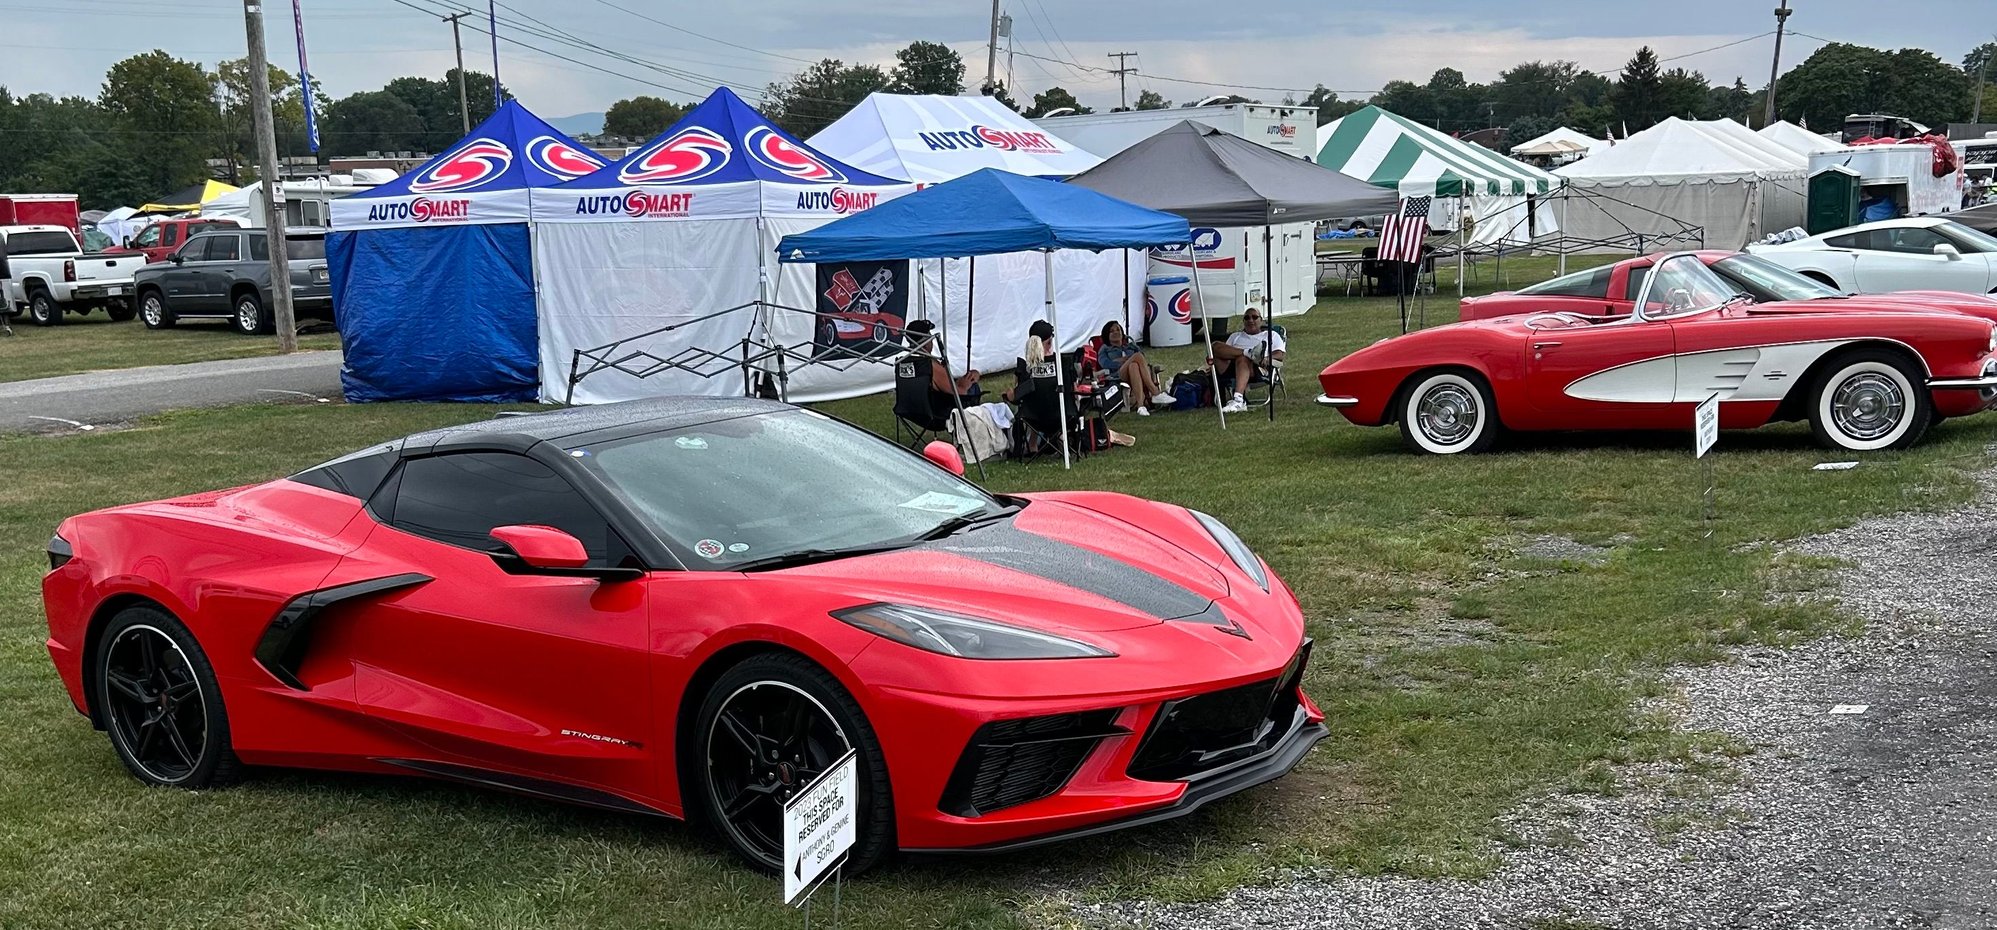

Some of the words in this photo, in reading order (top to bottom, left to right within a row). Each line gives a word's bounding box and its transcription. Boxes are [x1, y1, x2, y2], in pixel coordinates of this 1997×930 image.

[918, 125, 1056, 151] AUTOSMART
[368, 197, 469, 222] AUTOSMART
[576, 190, 692, 217] AUTOSMART
[561, 729, 628, 745] STINGRAY
[793, 796, 812, 821] 2023
[813, 784, 828, 803] FUN
[829, 766, 849, 788] FIELD
[802, 805, 818, 826] THIS
[819, 787, 839, 813] SPACE
[798, 808, 830, 843] RESERVED
[832, 796, 844, 817] FOR
[802, 833, 826, 861] ANTHONY
[816, 840, 835, 864] SGRO
